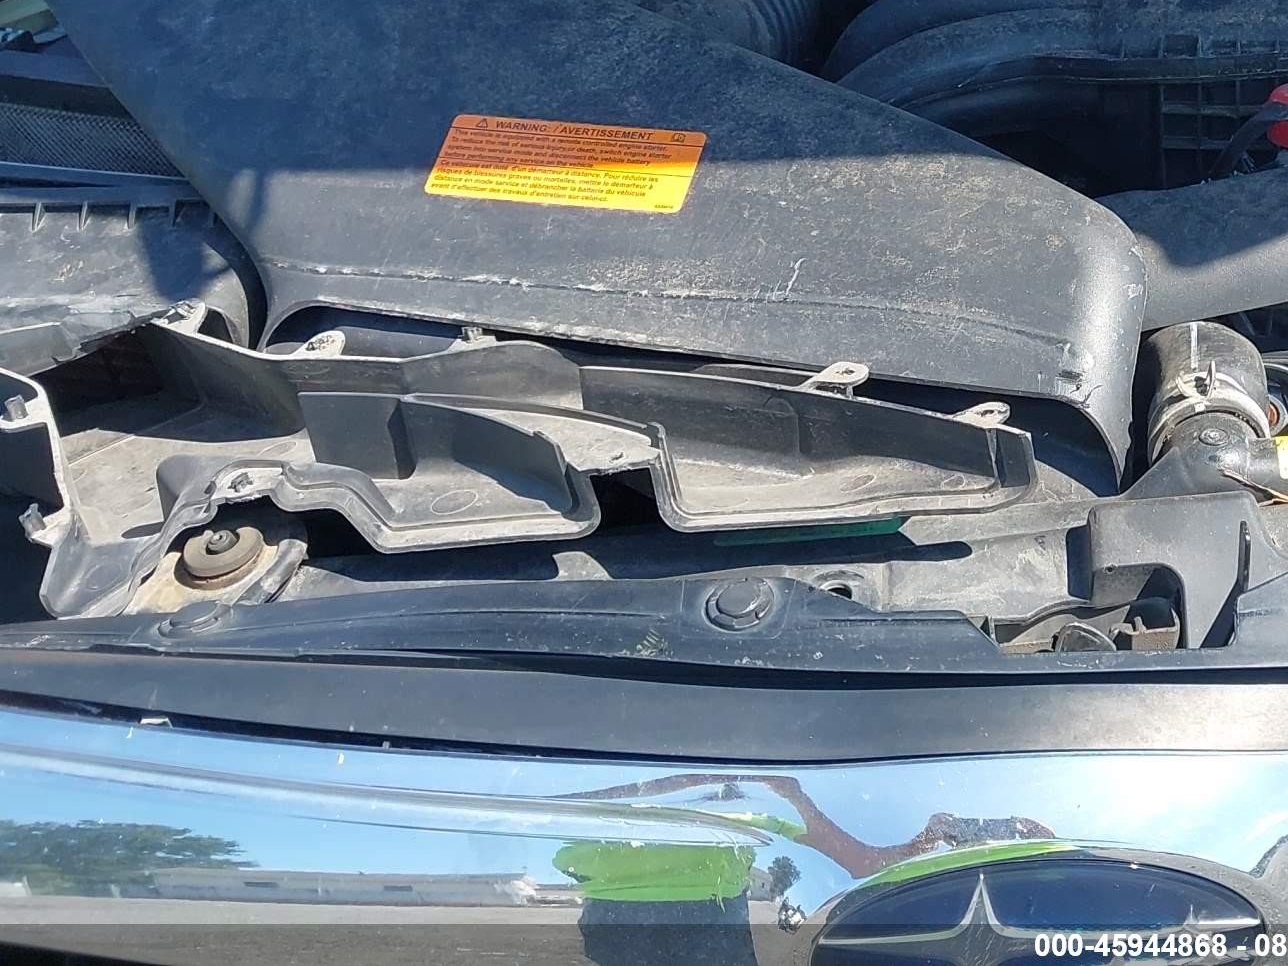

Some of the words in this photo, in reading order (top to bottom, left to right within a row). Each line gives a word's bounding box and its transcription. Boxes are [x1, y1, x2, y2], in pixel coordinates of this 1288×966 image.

[560, 126, 654, 140] AVERTISSEMENT
[582, 139, 618, 148] controlled
[618, 143, 643, 151] engine
[495, 180, 520, 188] service
